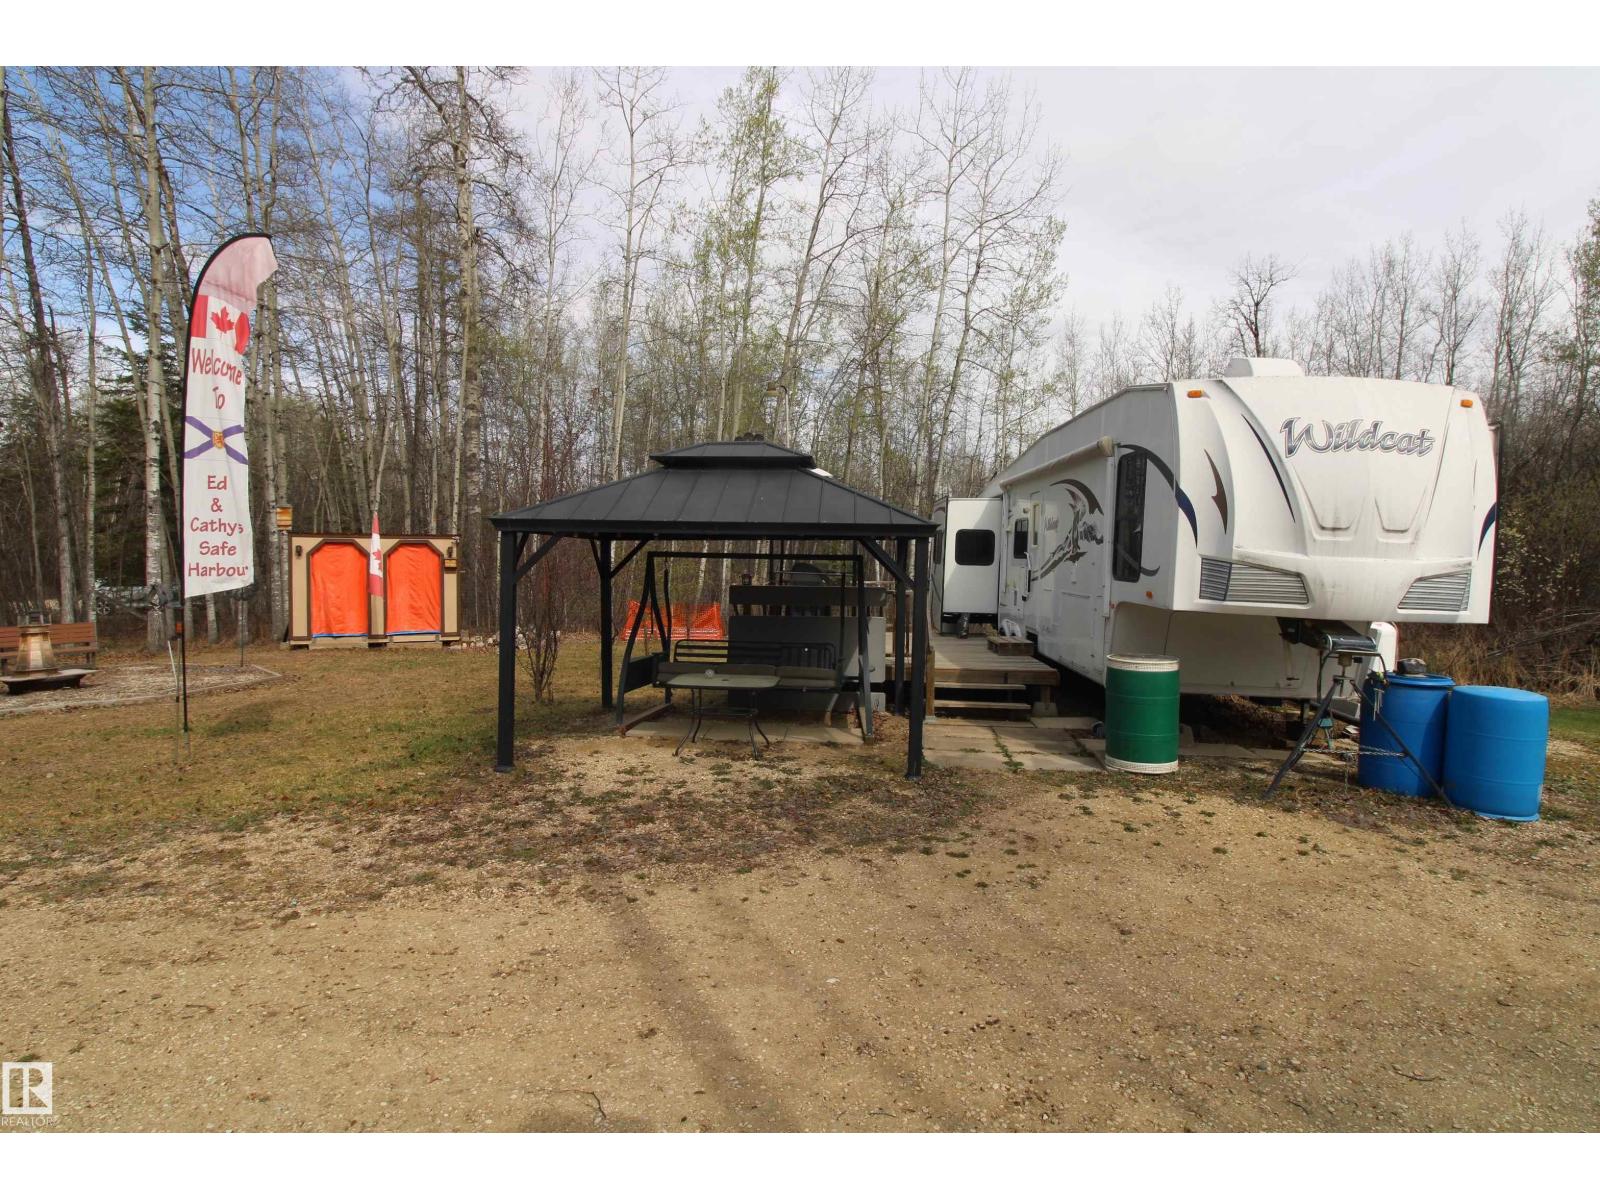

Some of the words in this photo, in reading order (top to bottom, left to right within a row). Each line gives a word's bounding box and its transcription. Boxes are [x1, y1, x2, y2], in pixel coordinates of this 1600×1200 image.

[212, 386, 225, 409] To
[1280, 417, 1435, 457] Wildcat
[207, 475, 228, 490] Ed
[210, 498, 223, 513] &
[199, 541, 237, 556] Safe
[188, 562, 248, 577] Harbou
